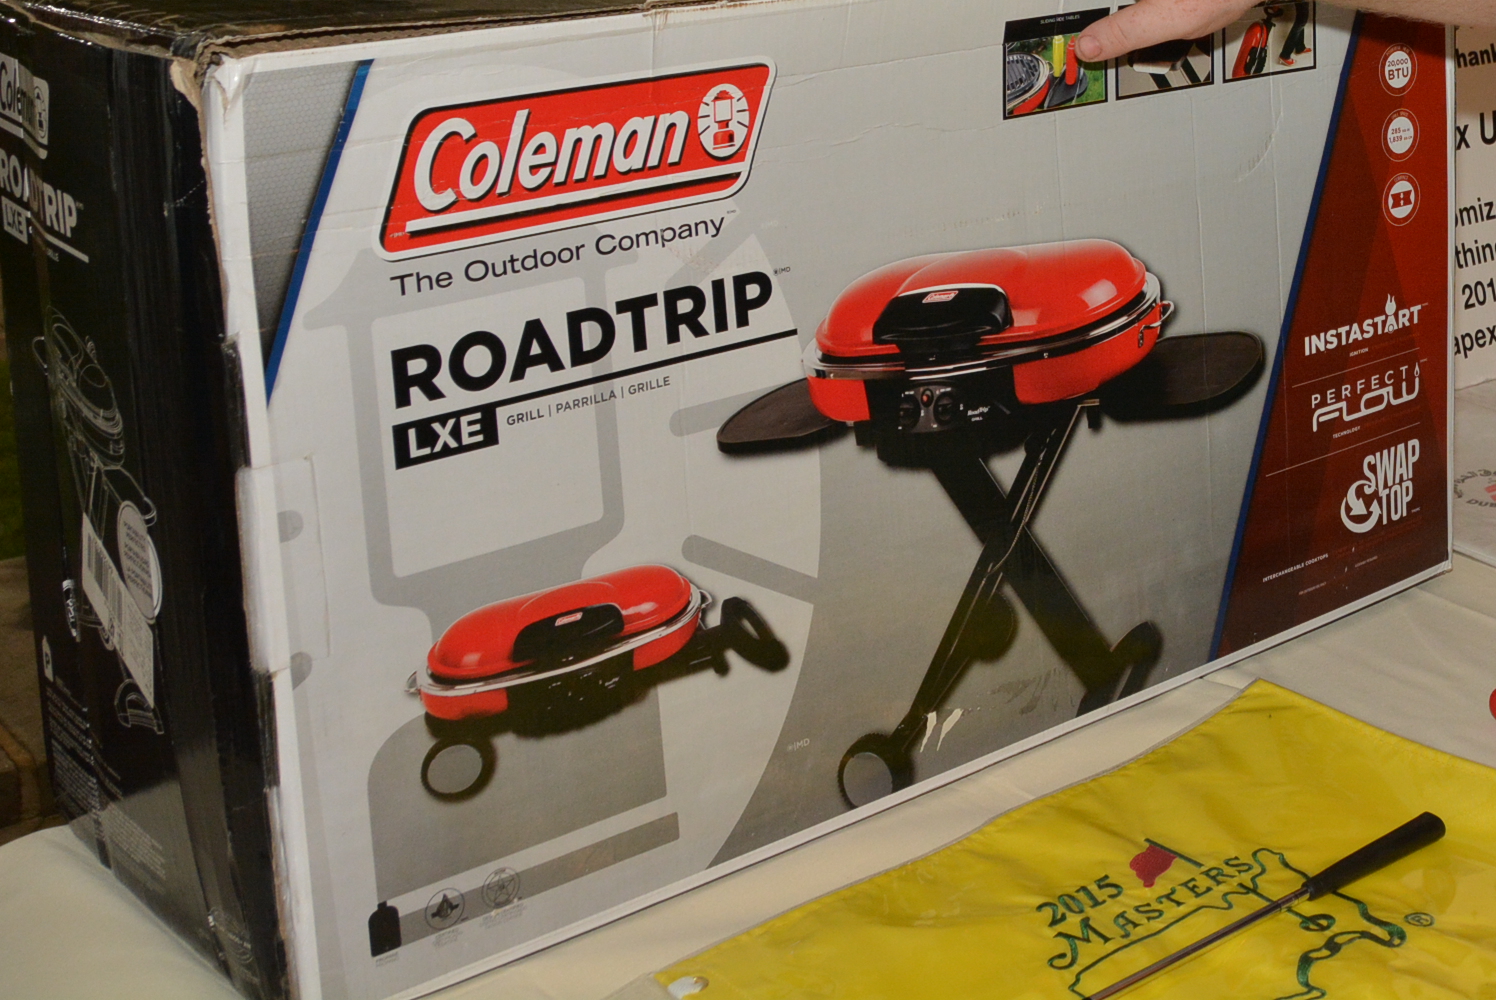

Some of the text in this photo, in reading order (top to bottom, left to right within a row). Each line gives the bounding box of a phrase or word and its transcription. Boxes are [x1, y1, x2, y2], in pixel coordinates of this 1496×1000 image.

[1387, 58, 1409, 68] 20,000
[1387, 67, 1409, 81] BTU
[414, 108, 690, 212] Coleman
[6, 204, 24, 235] LXE
[389, 215, 726, 297] The Outdoor Company
[390, 270, 774, 410] ROADTRIP
[1304, 304, 1423, 357] INSTASTART
[1311, 365, 1408, 409] PERFECT
[1312, 376, 1420, 433] FLOW
[406, 375, 671, 459] LXE GRILL PARRILLA GRILLE
[1362, 438, 1420, 497] SWAP
[1380, 480, 1414, 526] TOP
[1262, 553, 1329, 583] INTERCHANGEABLE COOKTOPS
[1035, 875, 1124, 928] 2015
[1046, 855, 1254, 971] MASTERS
